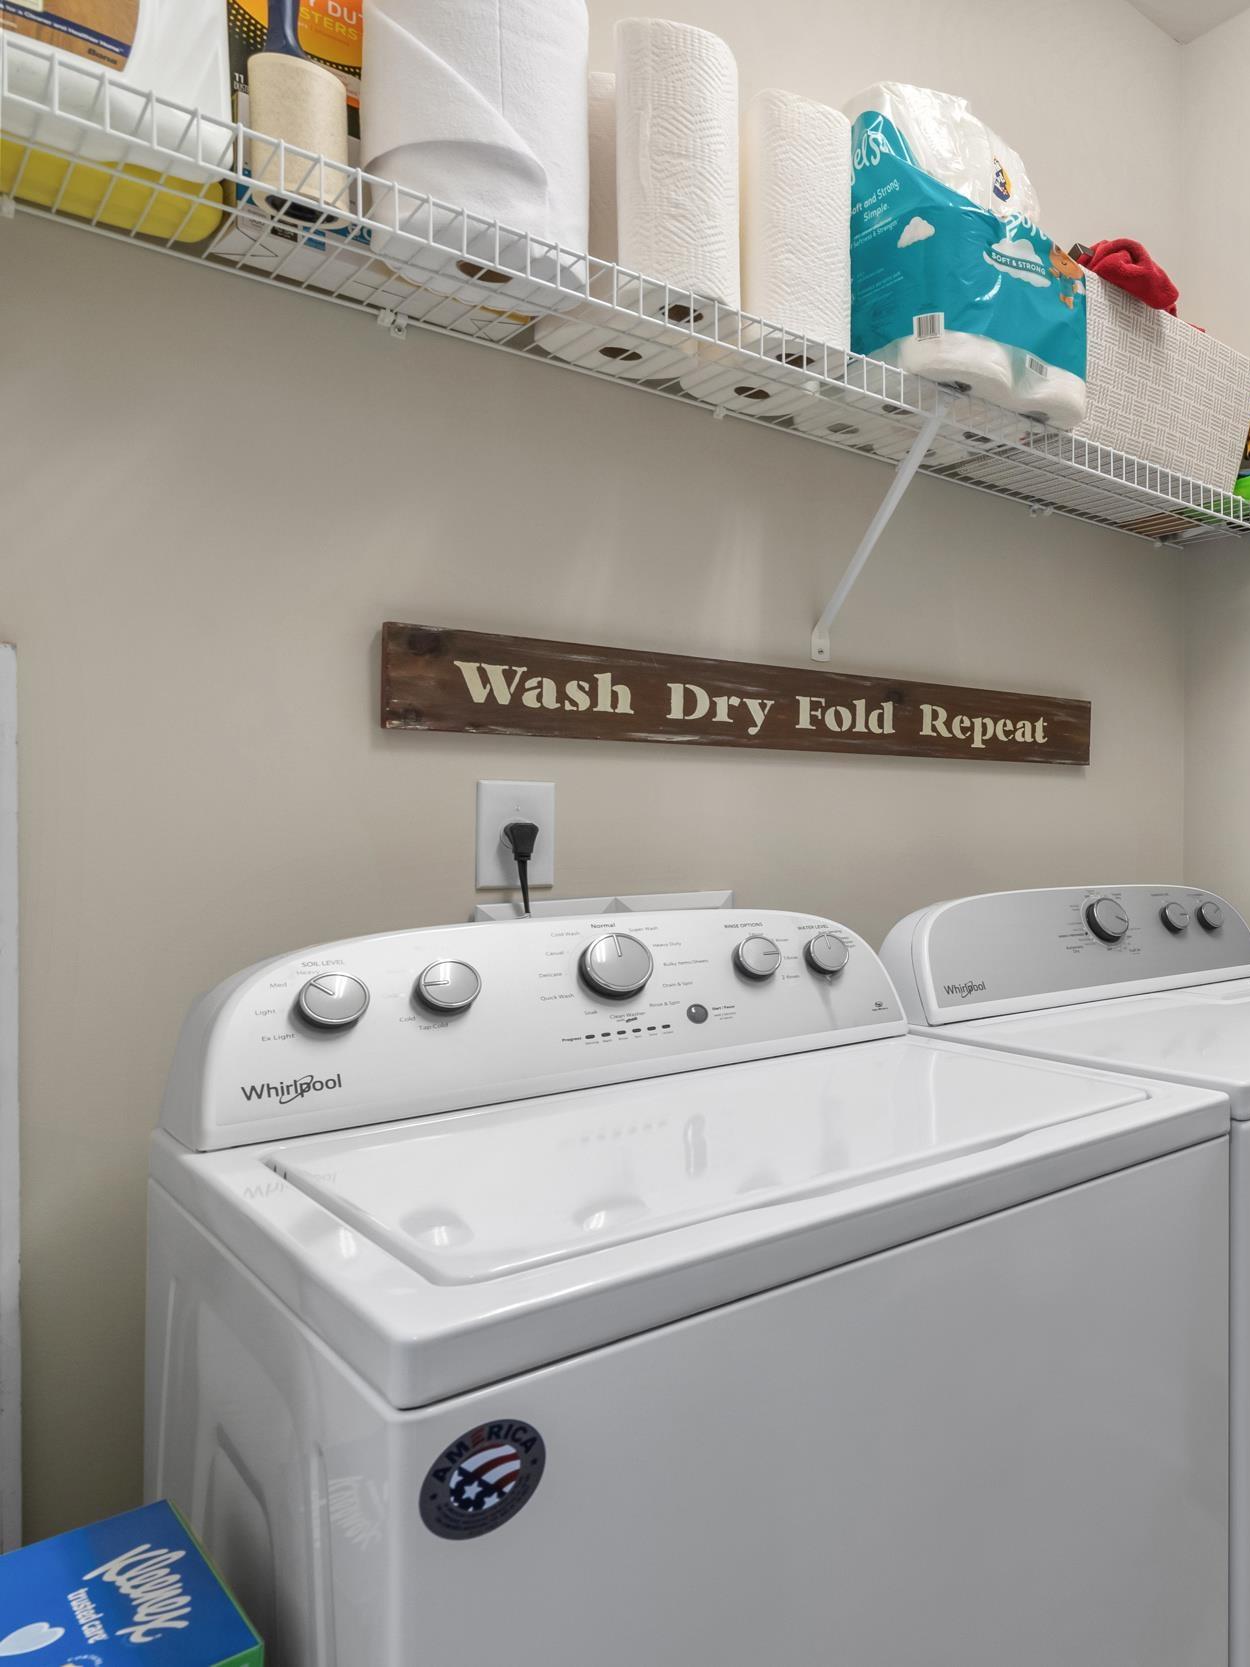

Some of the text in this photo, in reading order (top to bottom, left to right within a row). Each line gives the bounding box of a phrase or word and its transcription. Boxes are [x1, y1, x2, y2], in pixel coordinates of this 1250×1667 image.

[863, 192, 877, 208] and
[992, 251, 1013, 267] SOFT
[1019, 259, 1046, 276] STRONG
[454, 660, 1048, 749] Wash Dry Fold Repeat
[321, 959, 344, 967] LEVEL
[943, 980, 987, 998] Whirlpool
[255, 1009, 276, 1017] Light
[273, 1032, 297, 1041] Light
[240, 1073, 342, 1104] Whirlpool
[432, 1423, 538, 1483] AMERICA
[82, 1543, 192, 1643] Kleenex
[67, 1587, 104, 1625] trusted
[81, 1619, 109, 1644] care
